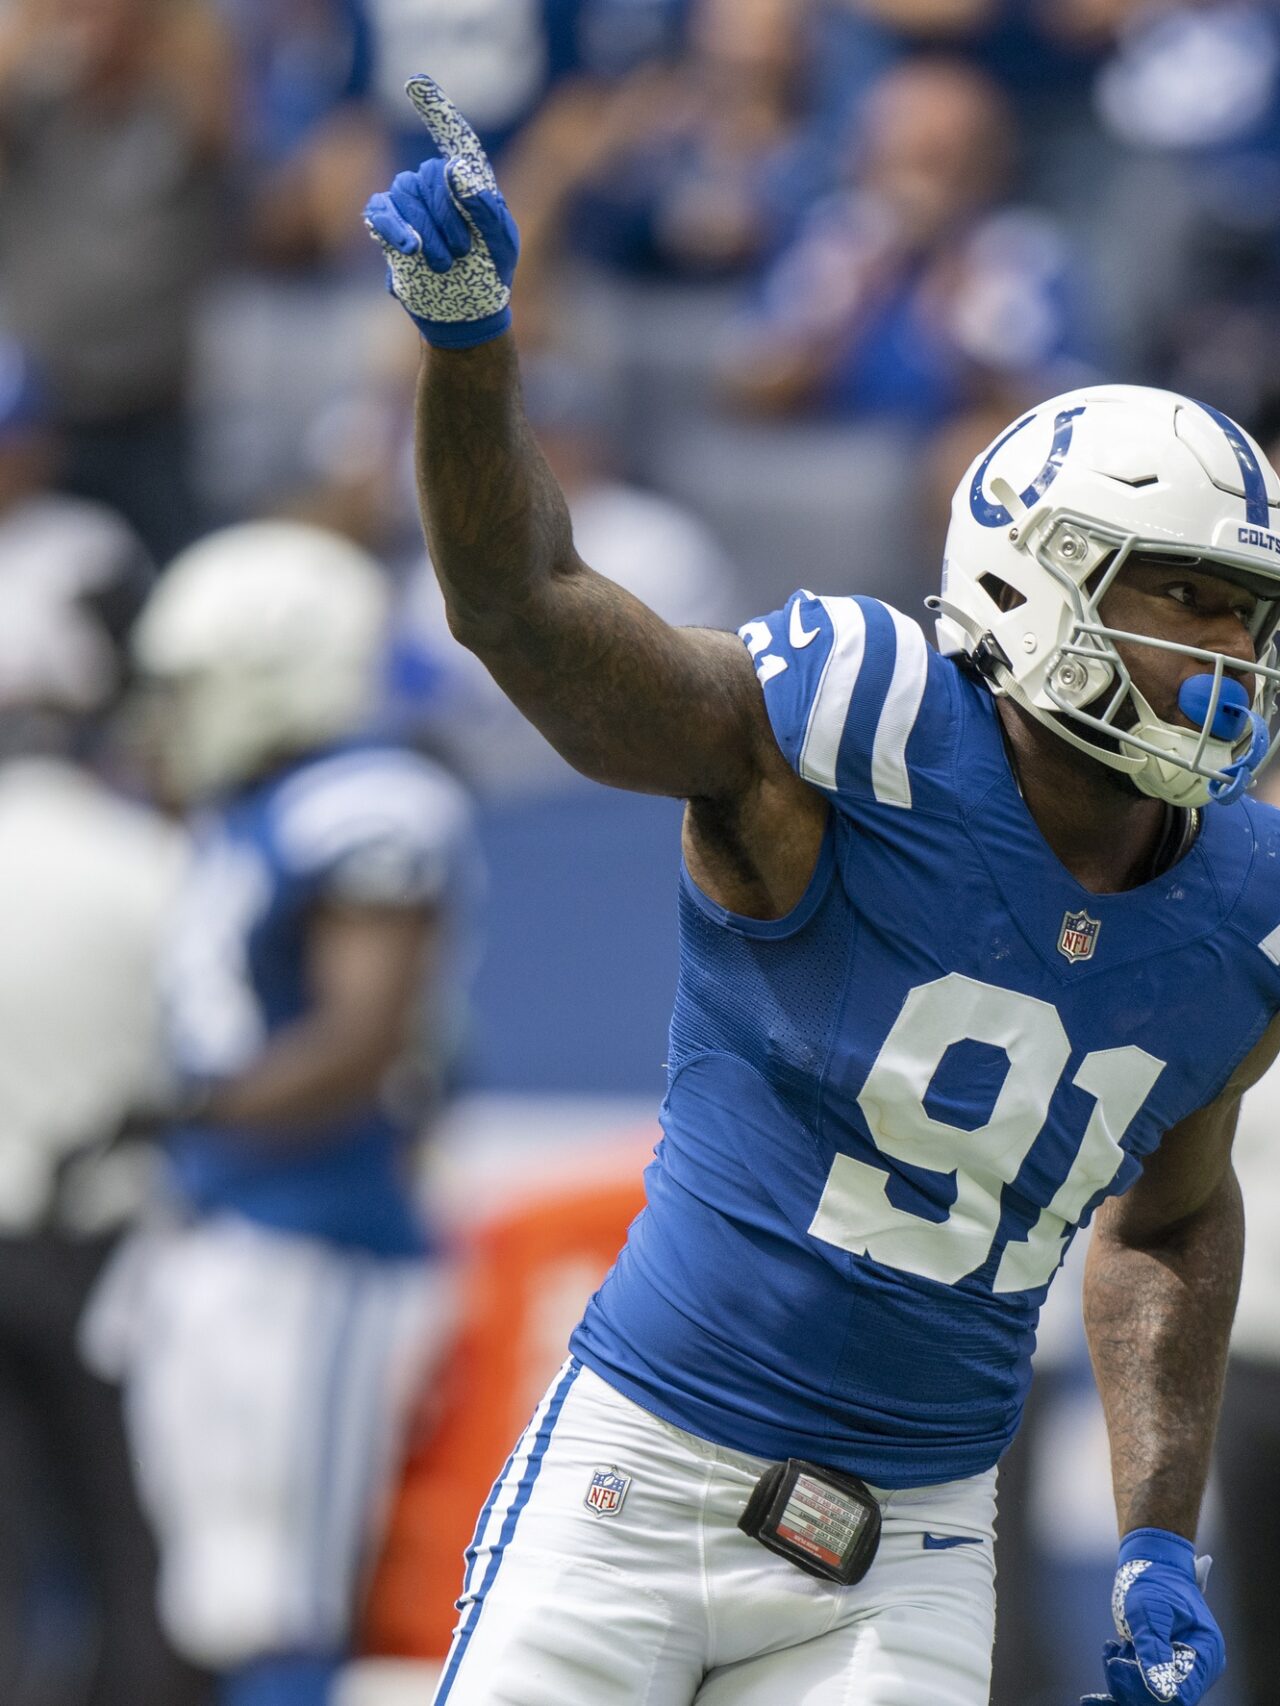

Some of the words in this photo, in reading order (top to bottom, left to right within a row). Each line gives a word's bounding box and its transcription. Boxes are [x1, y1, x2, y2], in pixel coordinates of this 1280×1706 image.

[1063, 931, 1089, 954] NFL
[807, 971, 1168, 1293] 91
[589, 1487, 617, 1509] NFL
